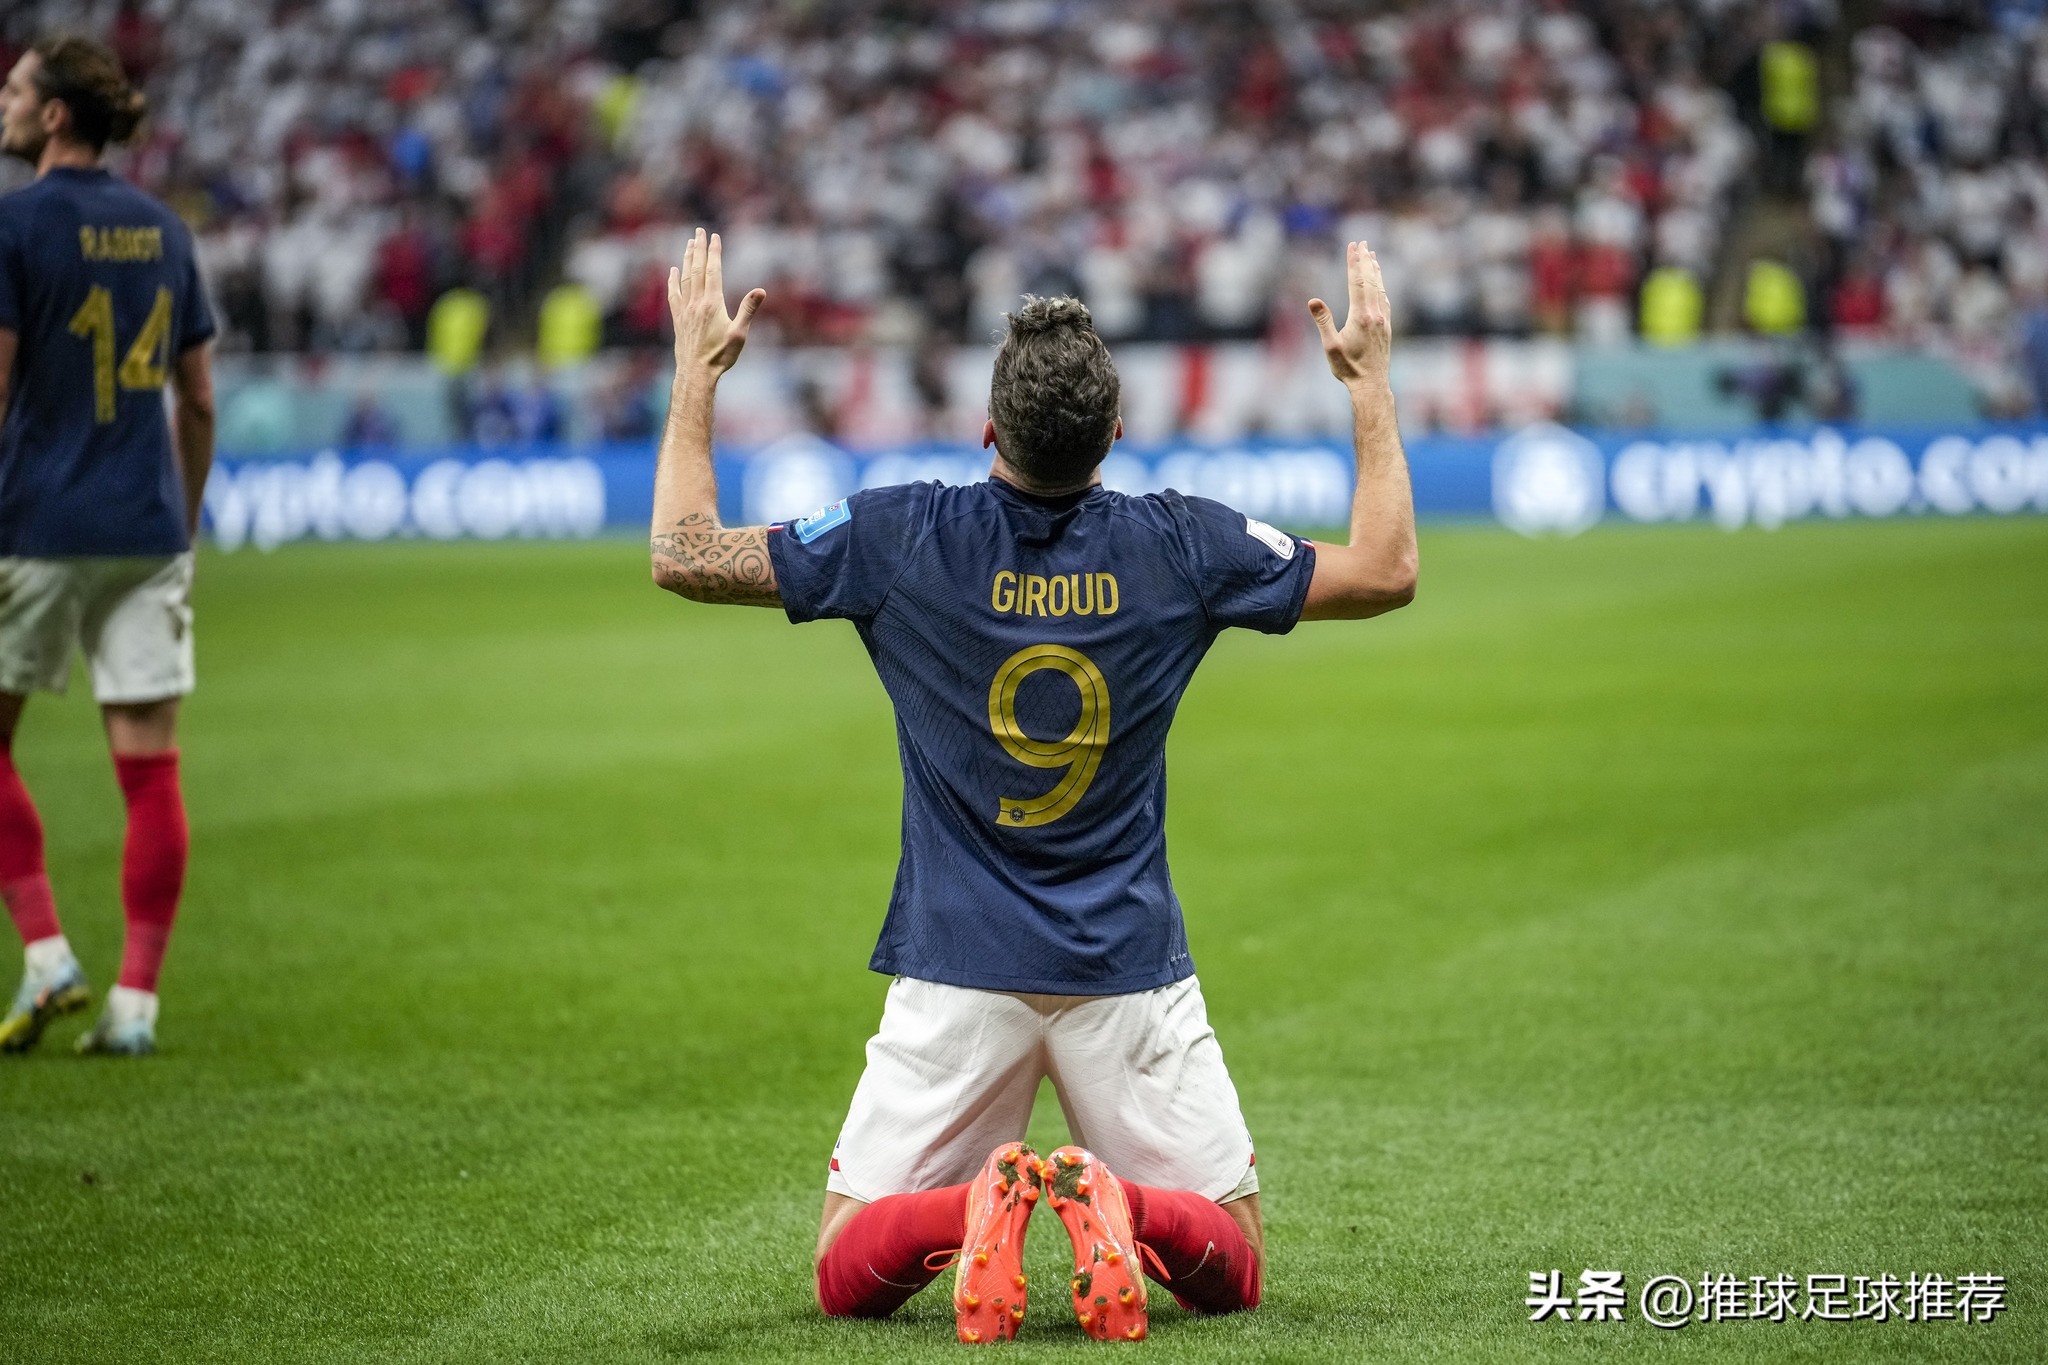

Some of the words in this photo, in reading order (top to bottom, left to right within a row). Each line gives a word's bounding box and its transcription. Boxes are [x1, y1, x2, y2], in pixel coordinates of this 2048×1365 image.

[69, 284, 173, 424] 14
[203, 450, 606, 552] ypto.com
[1611, 428, 2047, 531] crypto.co
[991, 569, 1120, 617] GIROUD
[988, 643, 1110, 828] 9
